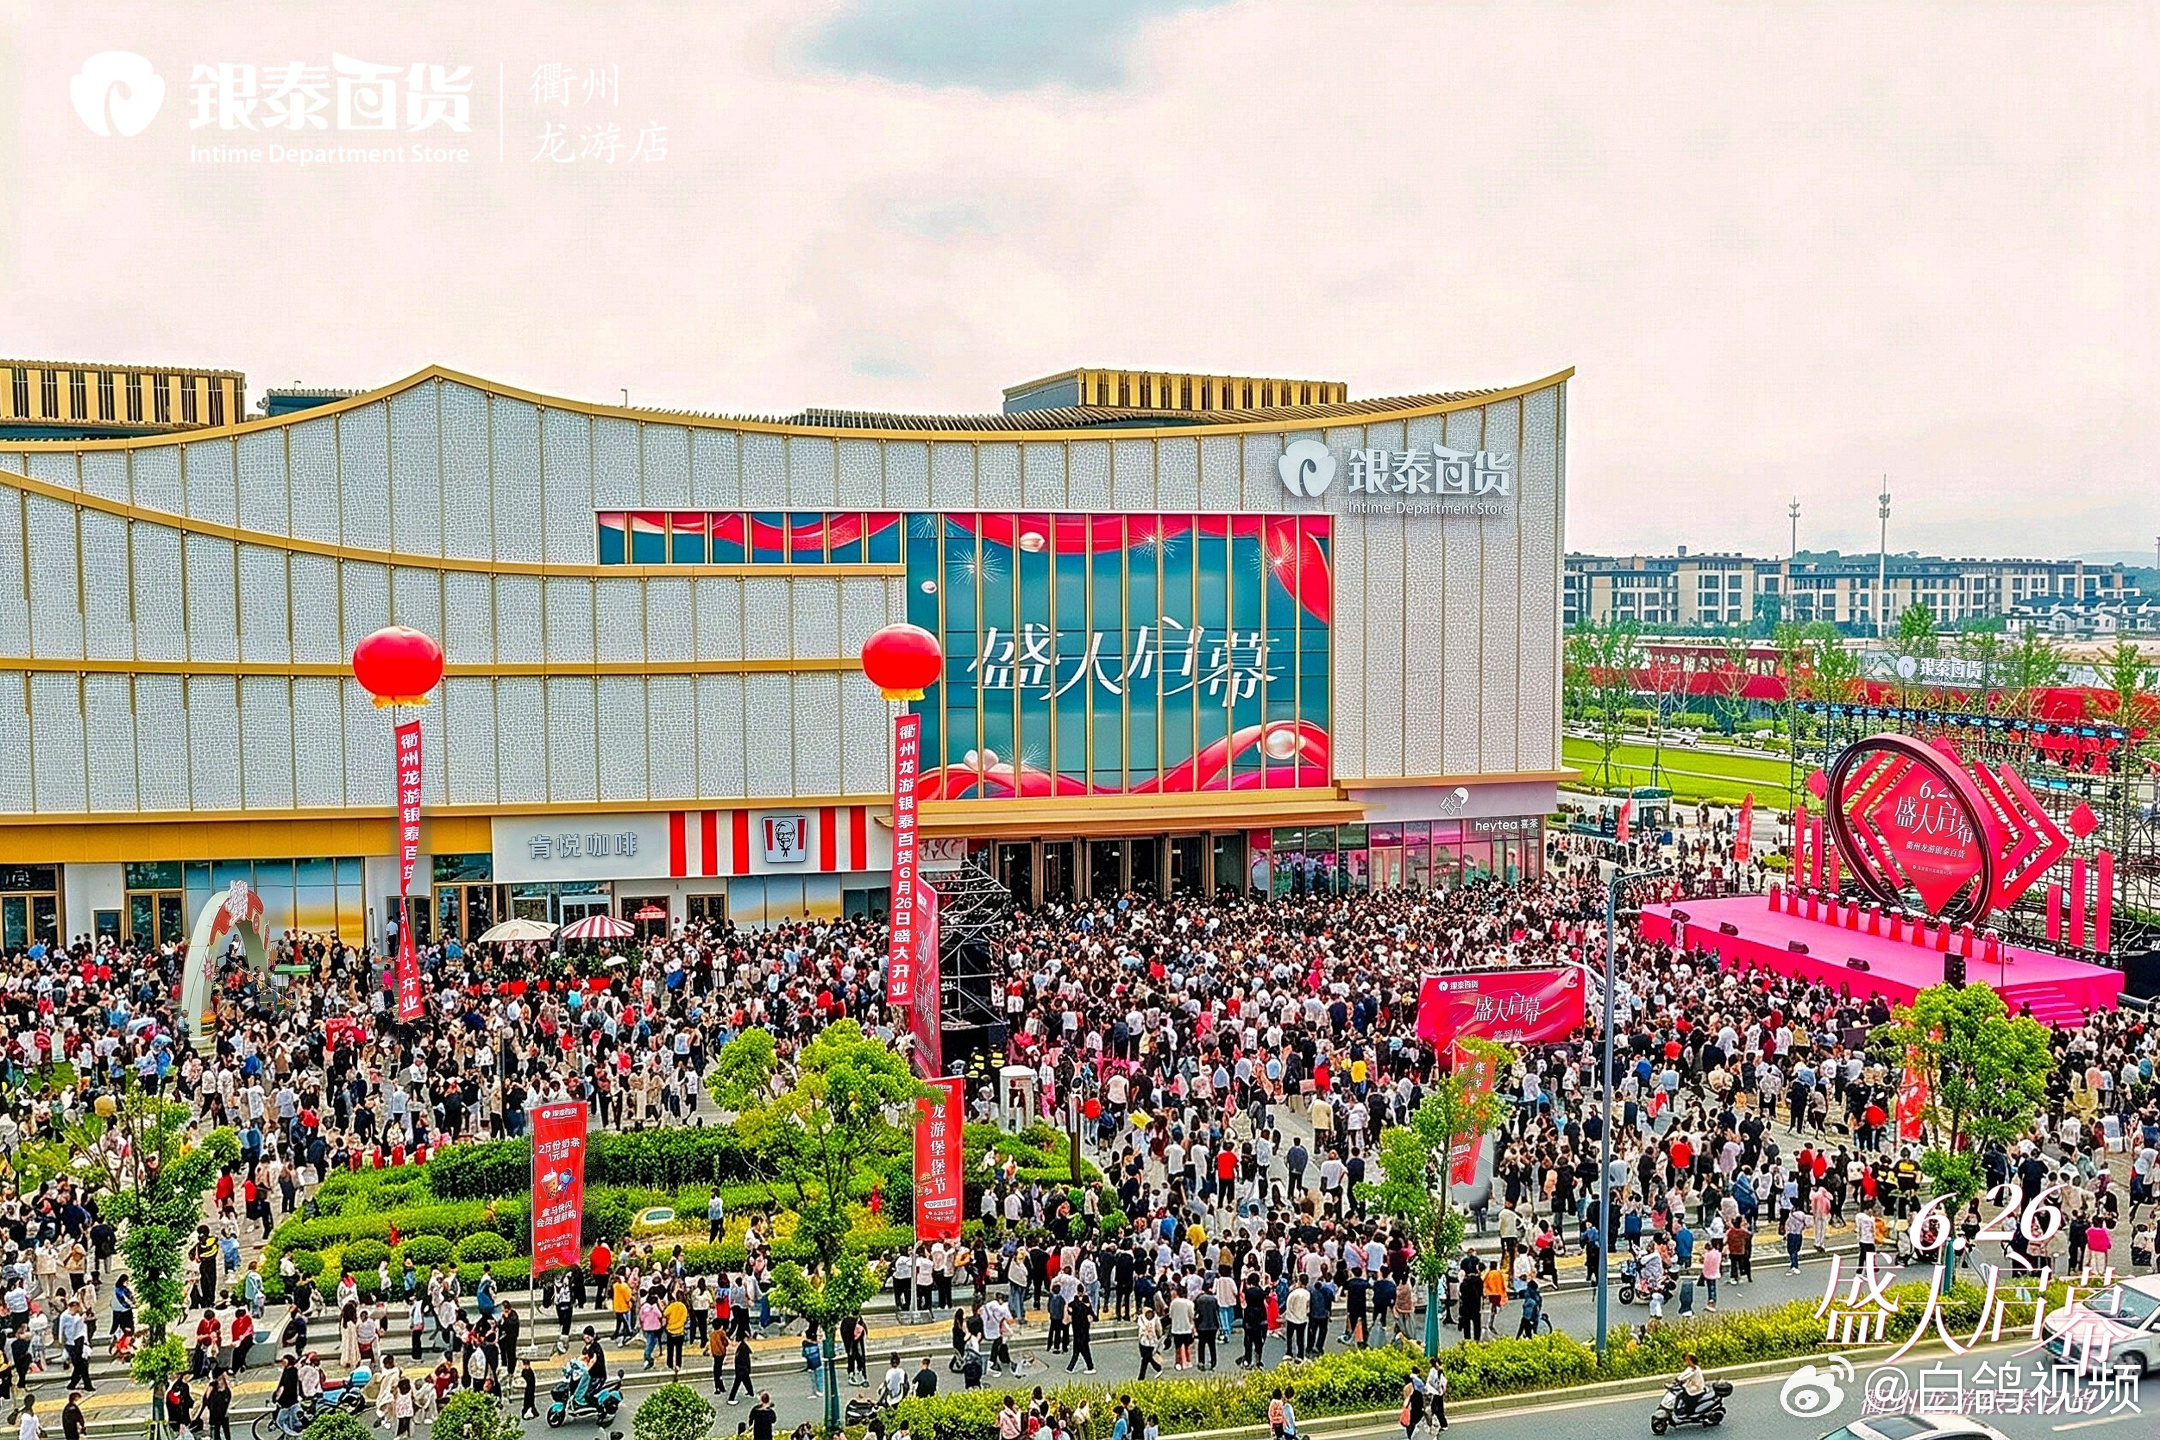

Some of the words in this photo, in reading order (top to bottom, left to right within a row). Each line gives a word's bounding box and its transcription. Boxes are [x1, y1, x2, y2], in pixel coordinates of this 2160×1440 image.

[1347, 442, 1511, 496] 银泰百货
[1347, 502, 1391, 514] Intime
[1396, 501, 1475, 517] Department
[1477, 502, 1511, 515] Store
[967, 616, 1286, 708] 盛大启幕
[1920, 656, 1984, 680] 银泰百货
[1475, 820, 1518, 832] heytea
[1520, 818, 1539, 829] 喜茶
[528, 832, 637, 859] 肯悦咖啡
[892, 723, 916, 997] 衢州龙游银泰百货6月26日盛大开业
[1473, 992, 1544, 1026] 盛大启幕
[538, 1137, 581, 1154] 2万份奶茶
[930, 1103, 947, 1195] 龙游堡堡节
